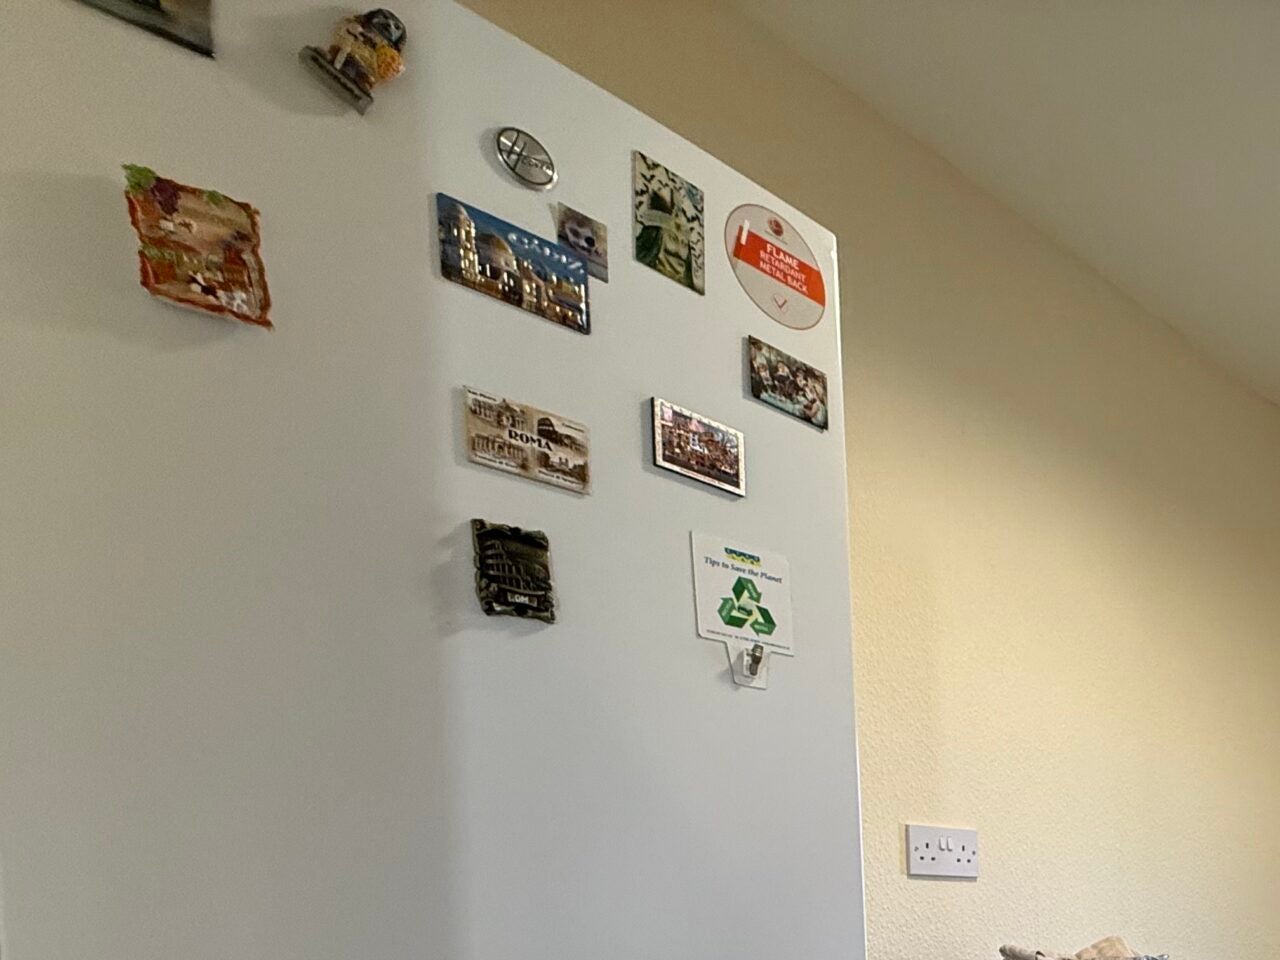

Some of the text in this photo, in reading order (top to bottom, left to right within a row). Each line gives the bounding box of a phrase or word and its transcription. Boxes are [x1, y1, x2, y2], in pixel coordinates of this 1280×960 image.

[760, 250, 806, 282] RETARDANT
[766, 243, 799, 270] FLAME
[760, 260, 809, 295] METAL BACK
[508, 429, 553, 452] ROMA
[704, 556, 720, 567] Tips
[722, 561, 729, 569] to
[731, 563, 746, 574] Save
[760, 571, 783, 584] Planet
